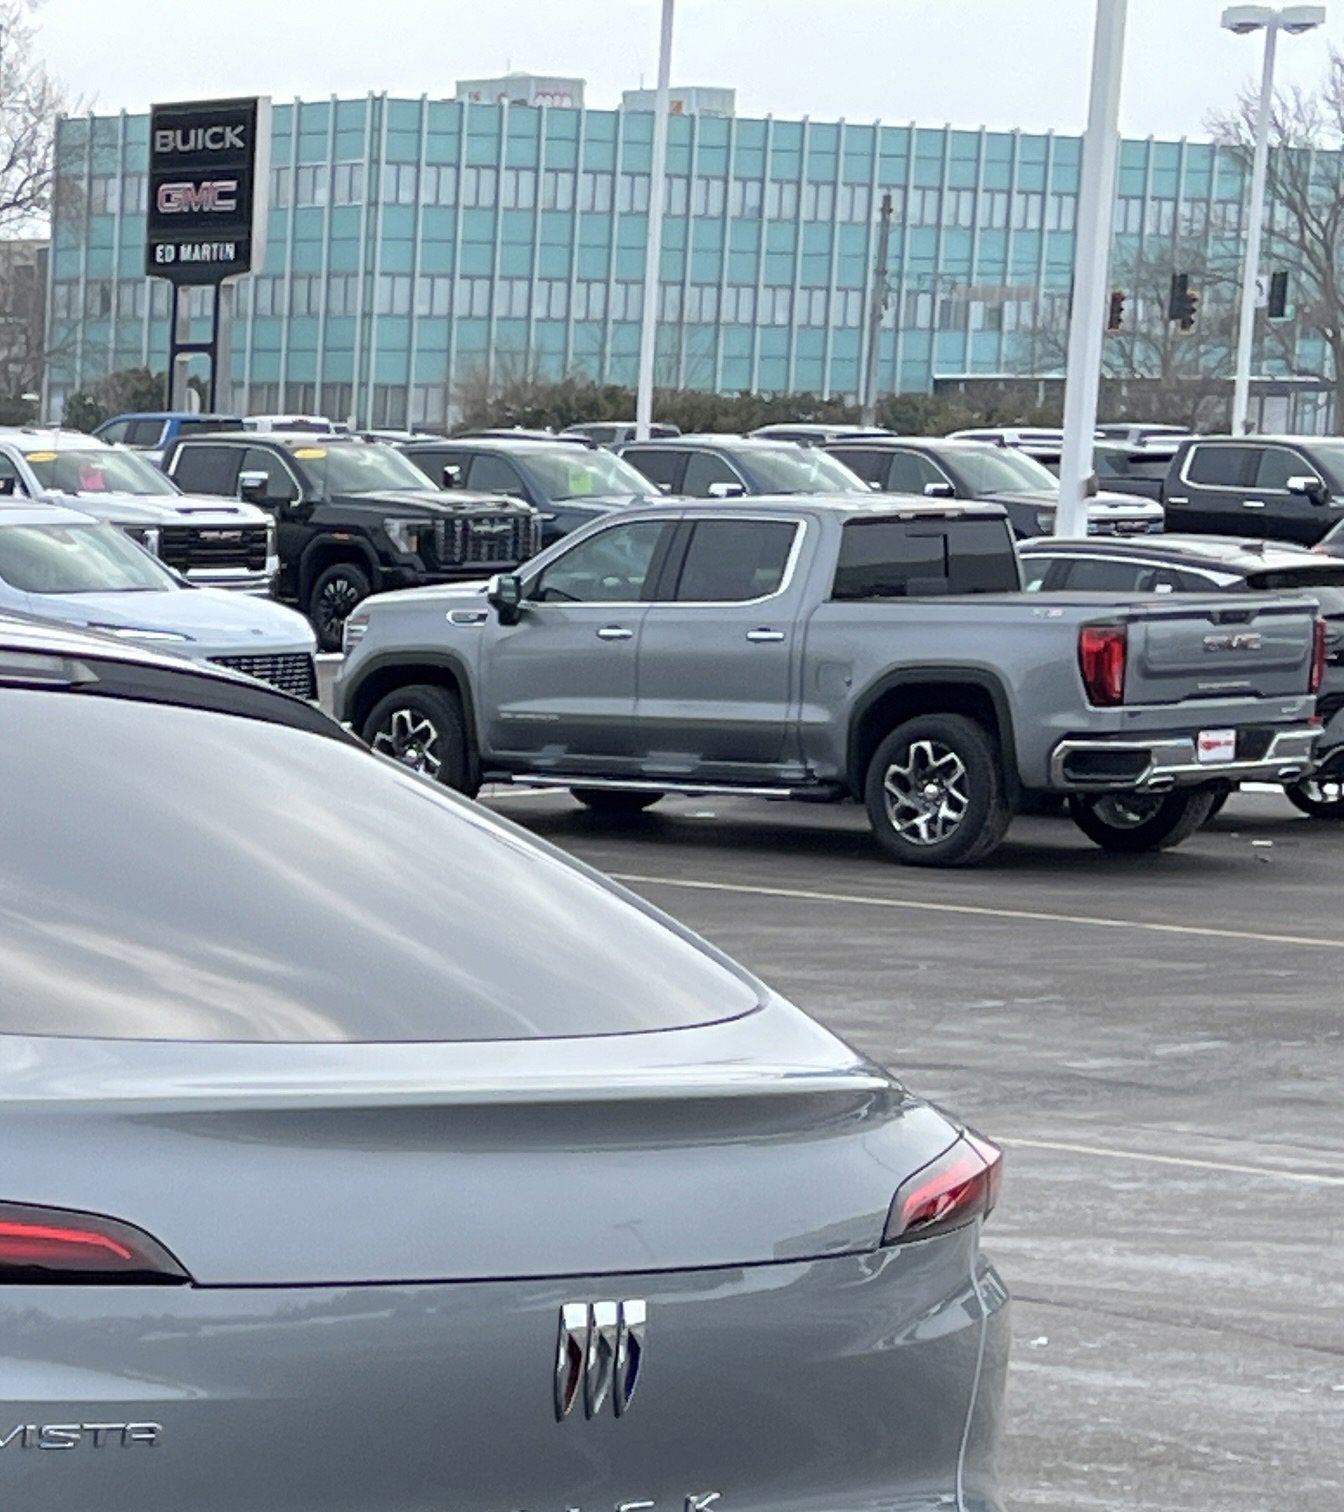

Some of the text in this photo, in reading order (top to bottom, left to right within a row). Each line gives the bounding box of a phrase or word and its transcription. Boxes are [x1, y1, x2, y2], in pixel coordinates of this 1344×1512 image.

[155, 125, 245, 152] BUICK
[158, 180, 238, 213] GMC
[156, 242, 235, 263] ED MARTIN
